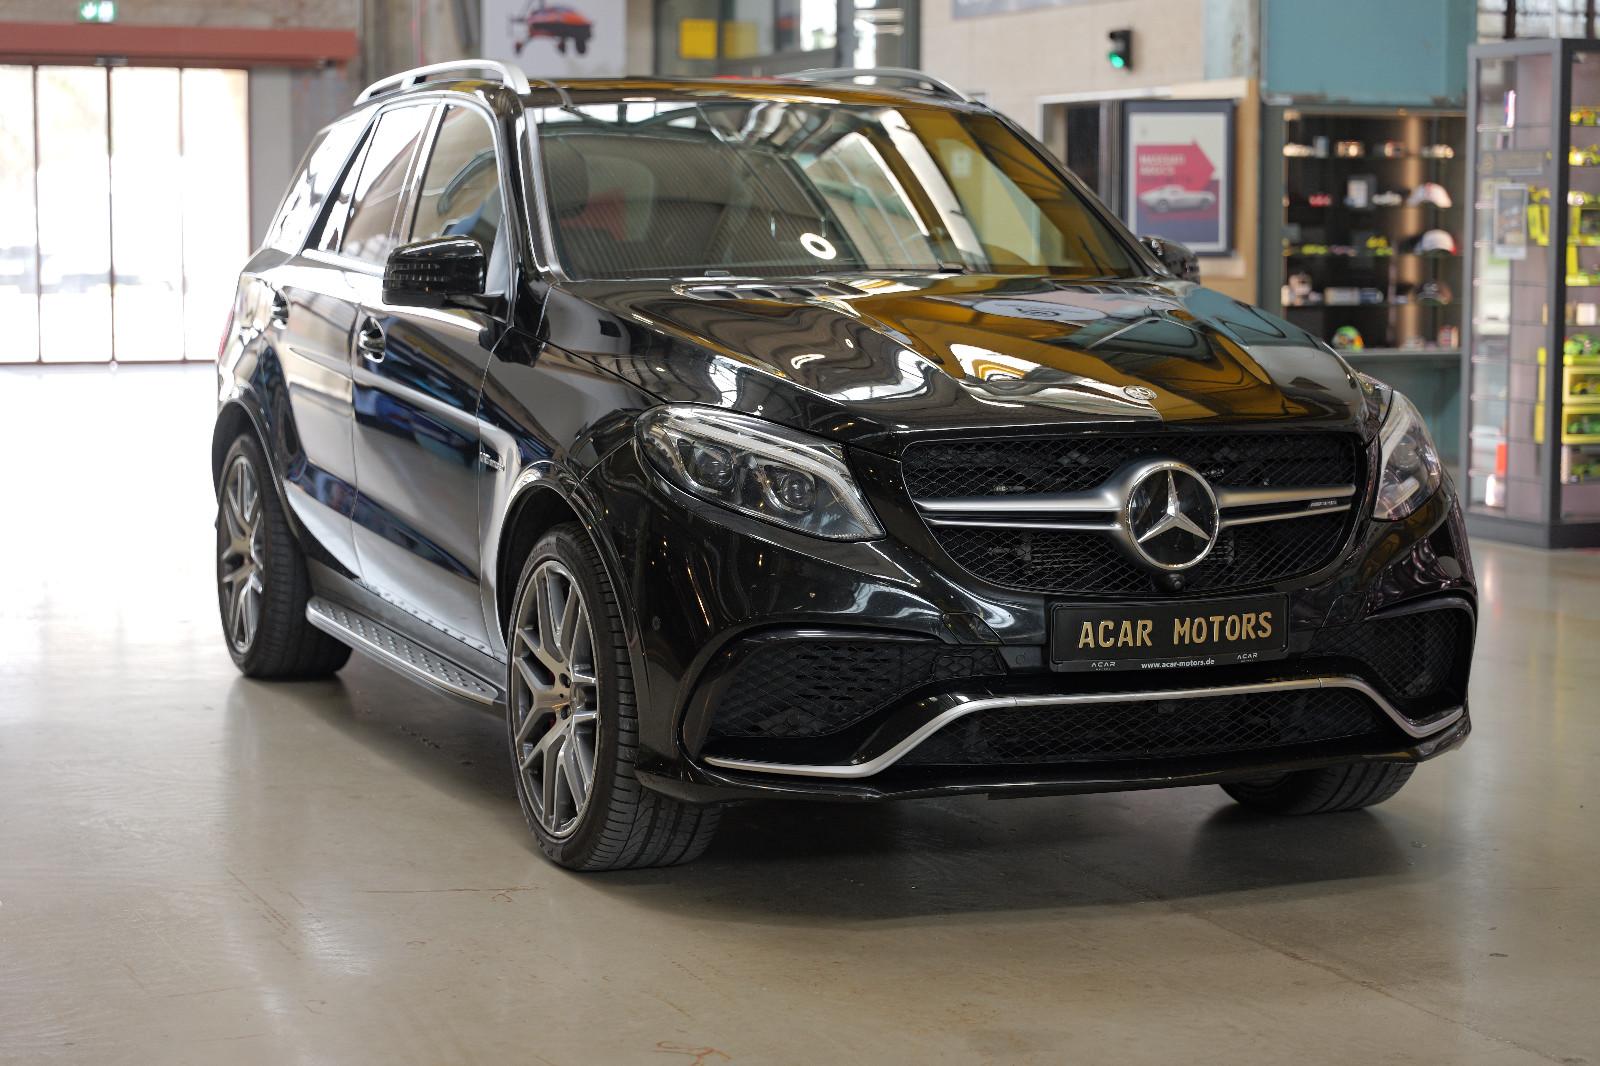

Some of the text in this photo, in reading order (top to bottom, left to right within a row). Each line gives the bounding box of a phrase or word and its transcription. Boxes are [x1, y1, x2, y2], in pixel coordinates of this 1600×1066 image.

[1078, 611, 1272, 649] ACAR MOTORS
[1236, 652, 1258, 660] ACAR
[1141, 657, 1215, 669] www.acar-motors.de
